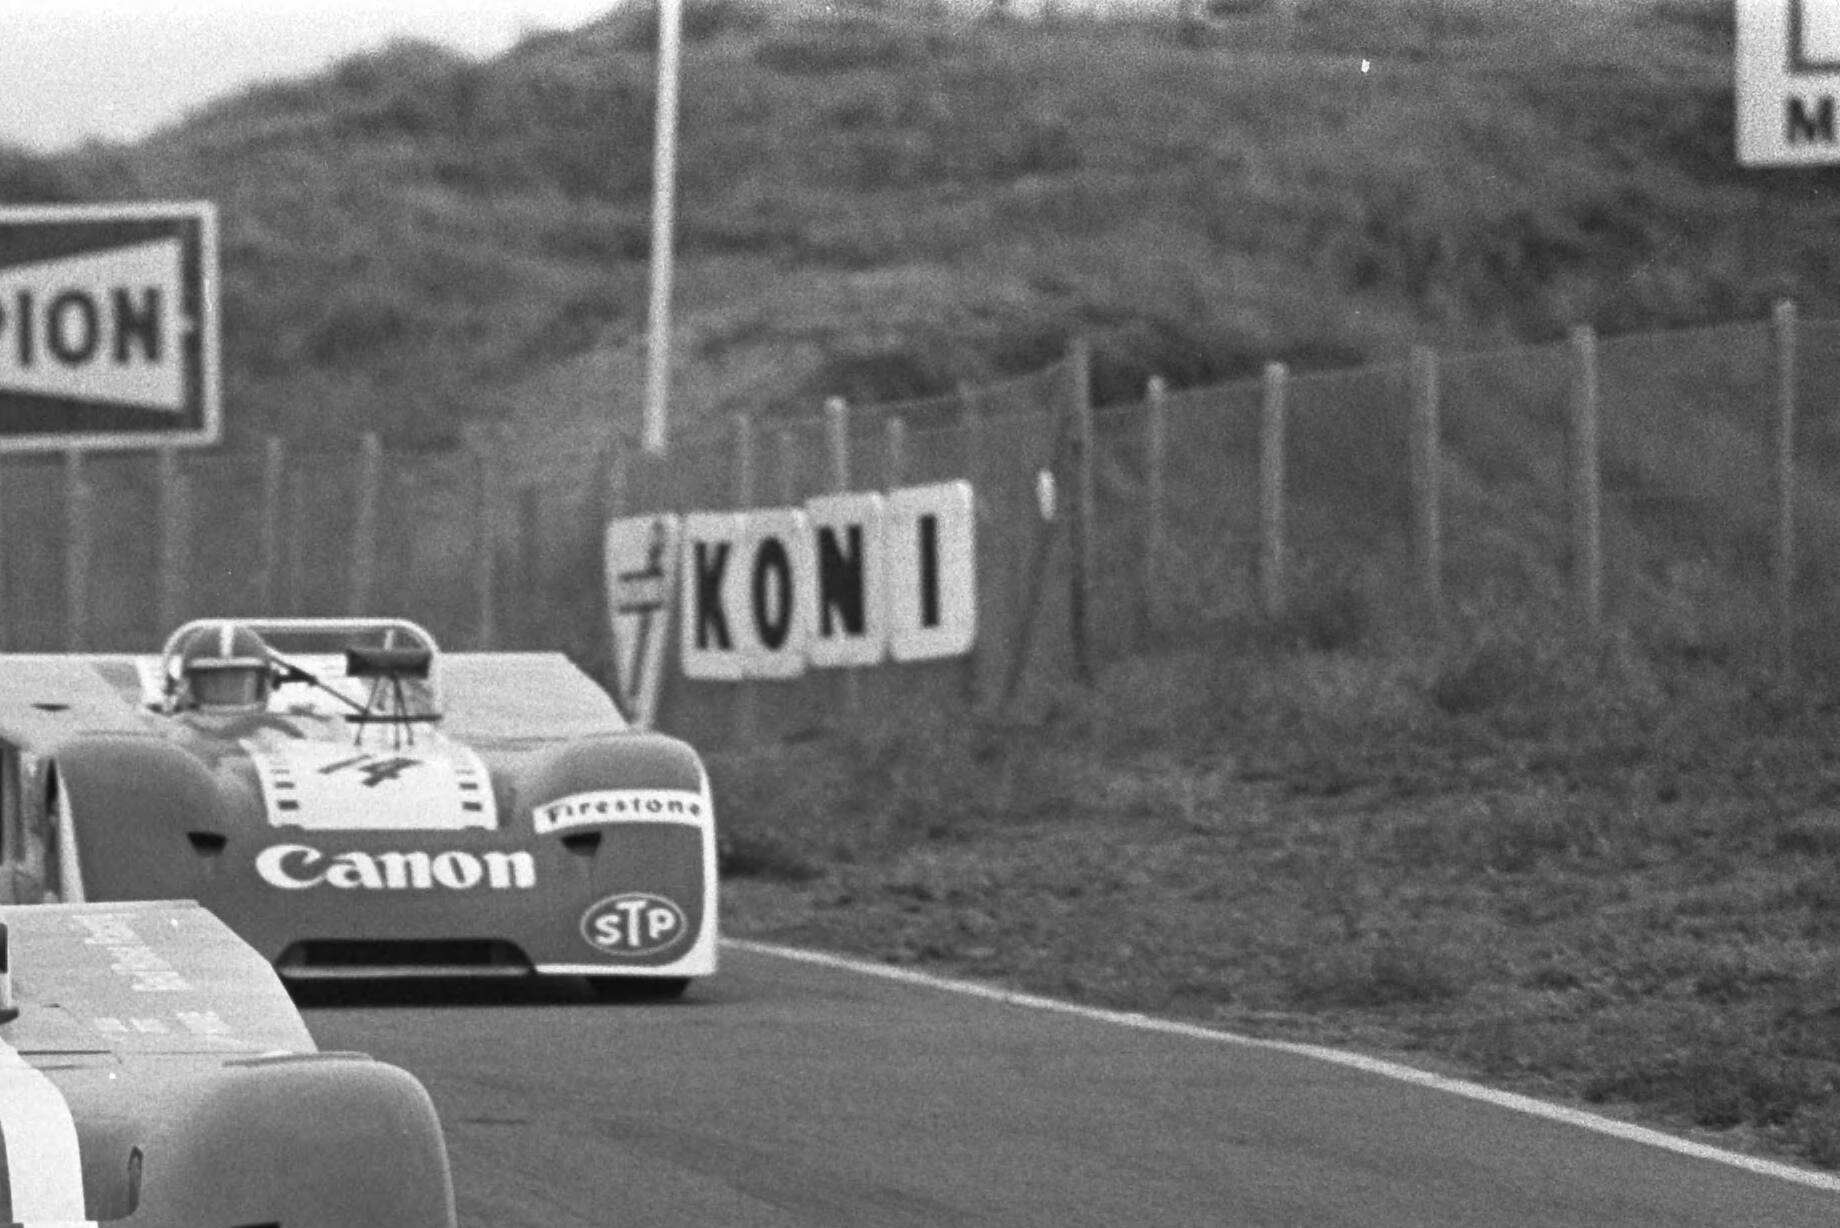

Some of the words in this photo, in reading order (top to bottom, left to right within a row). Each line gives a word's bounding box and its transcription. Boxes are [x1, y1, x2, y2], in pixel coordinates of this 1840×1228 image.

[694, 514, 940, 651] KONI
[546, 797, 701, 824] Firestone
[255, 844, 536, 889] Canon
[594, 899, 676, 947] STP
